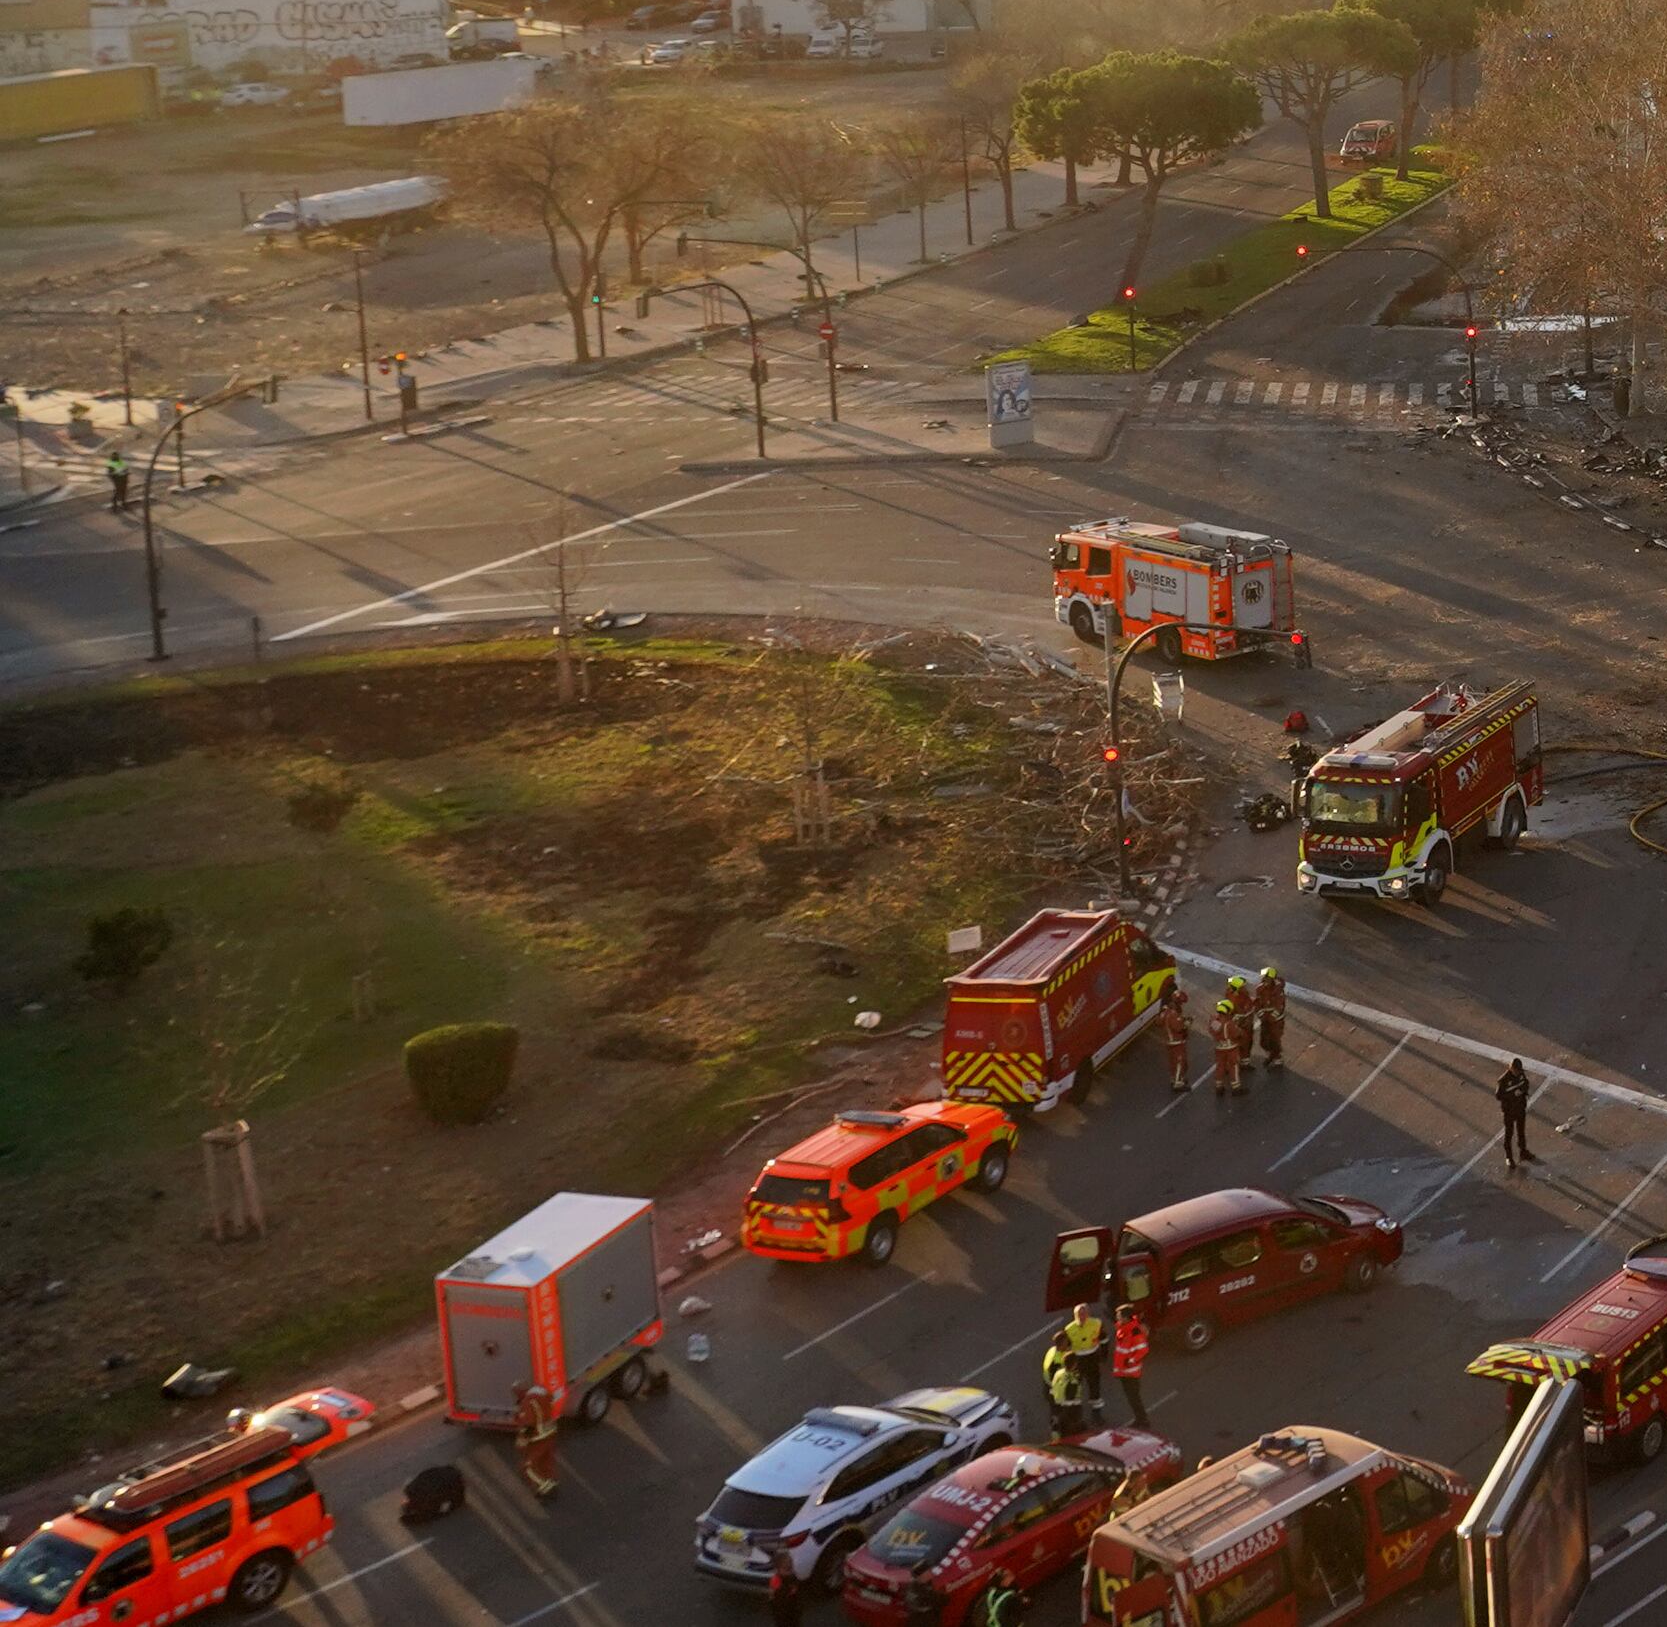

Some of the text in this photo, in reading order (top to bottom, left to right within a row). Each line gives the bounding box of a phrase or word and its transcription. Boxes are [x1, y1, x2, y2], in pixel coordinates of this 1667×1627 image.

[1133, 569, 1178, 589] BOMBERS
[792, 1431, 847, 1452] U-02
[930, 1485, 992, 1512] UMJ-2
